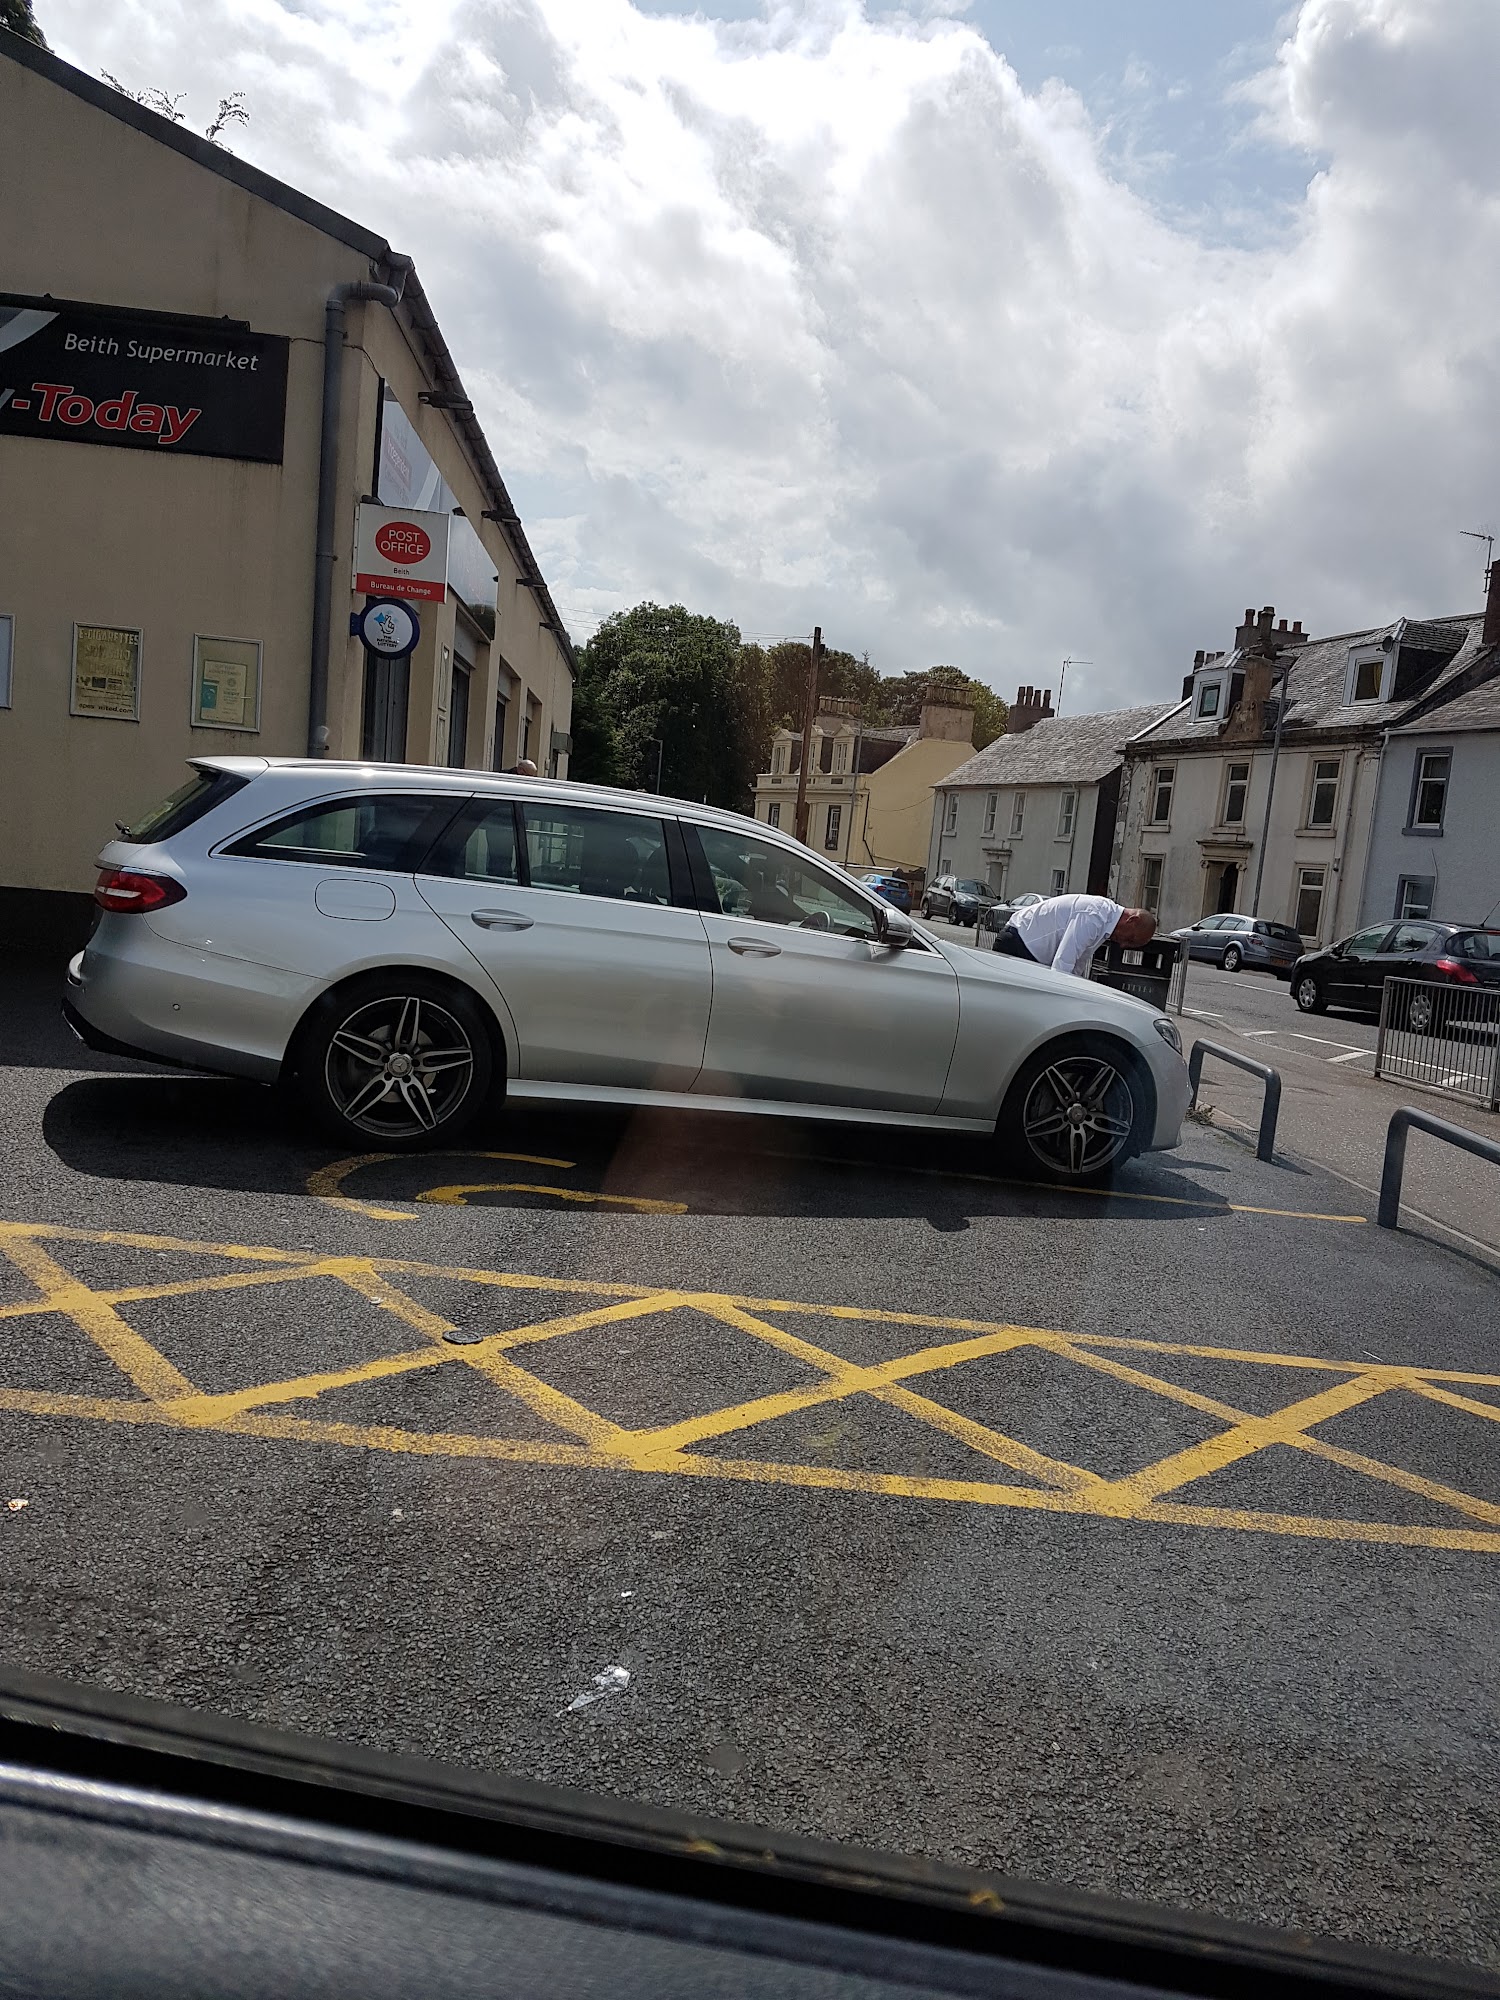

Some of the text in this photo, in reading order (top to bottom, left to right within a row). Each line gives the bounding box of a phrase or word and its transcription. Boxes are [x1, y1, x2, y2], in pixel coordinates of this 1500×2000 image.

[64, 333, 259, 371] Beith Supermarket
[388, 529, 420, 543] POST
[380, 540, 424, 555] OFFICE
[393, 567, 410, 576] Beith
[370, 581, 395, 590] Bureau
[406, 585, 431, 595] Change
